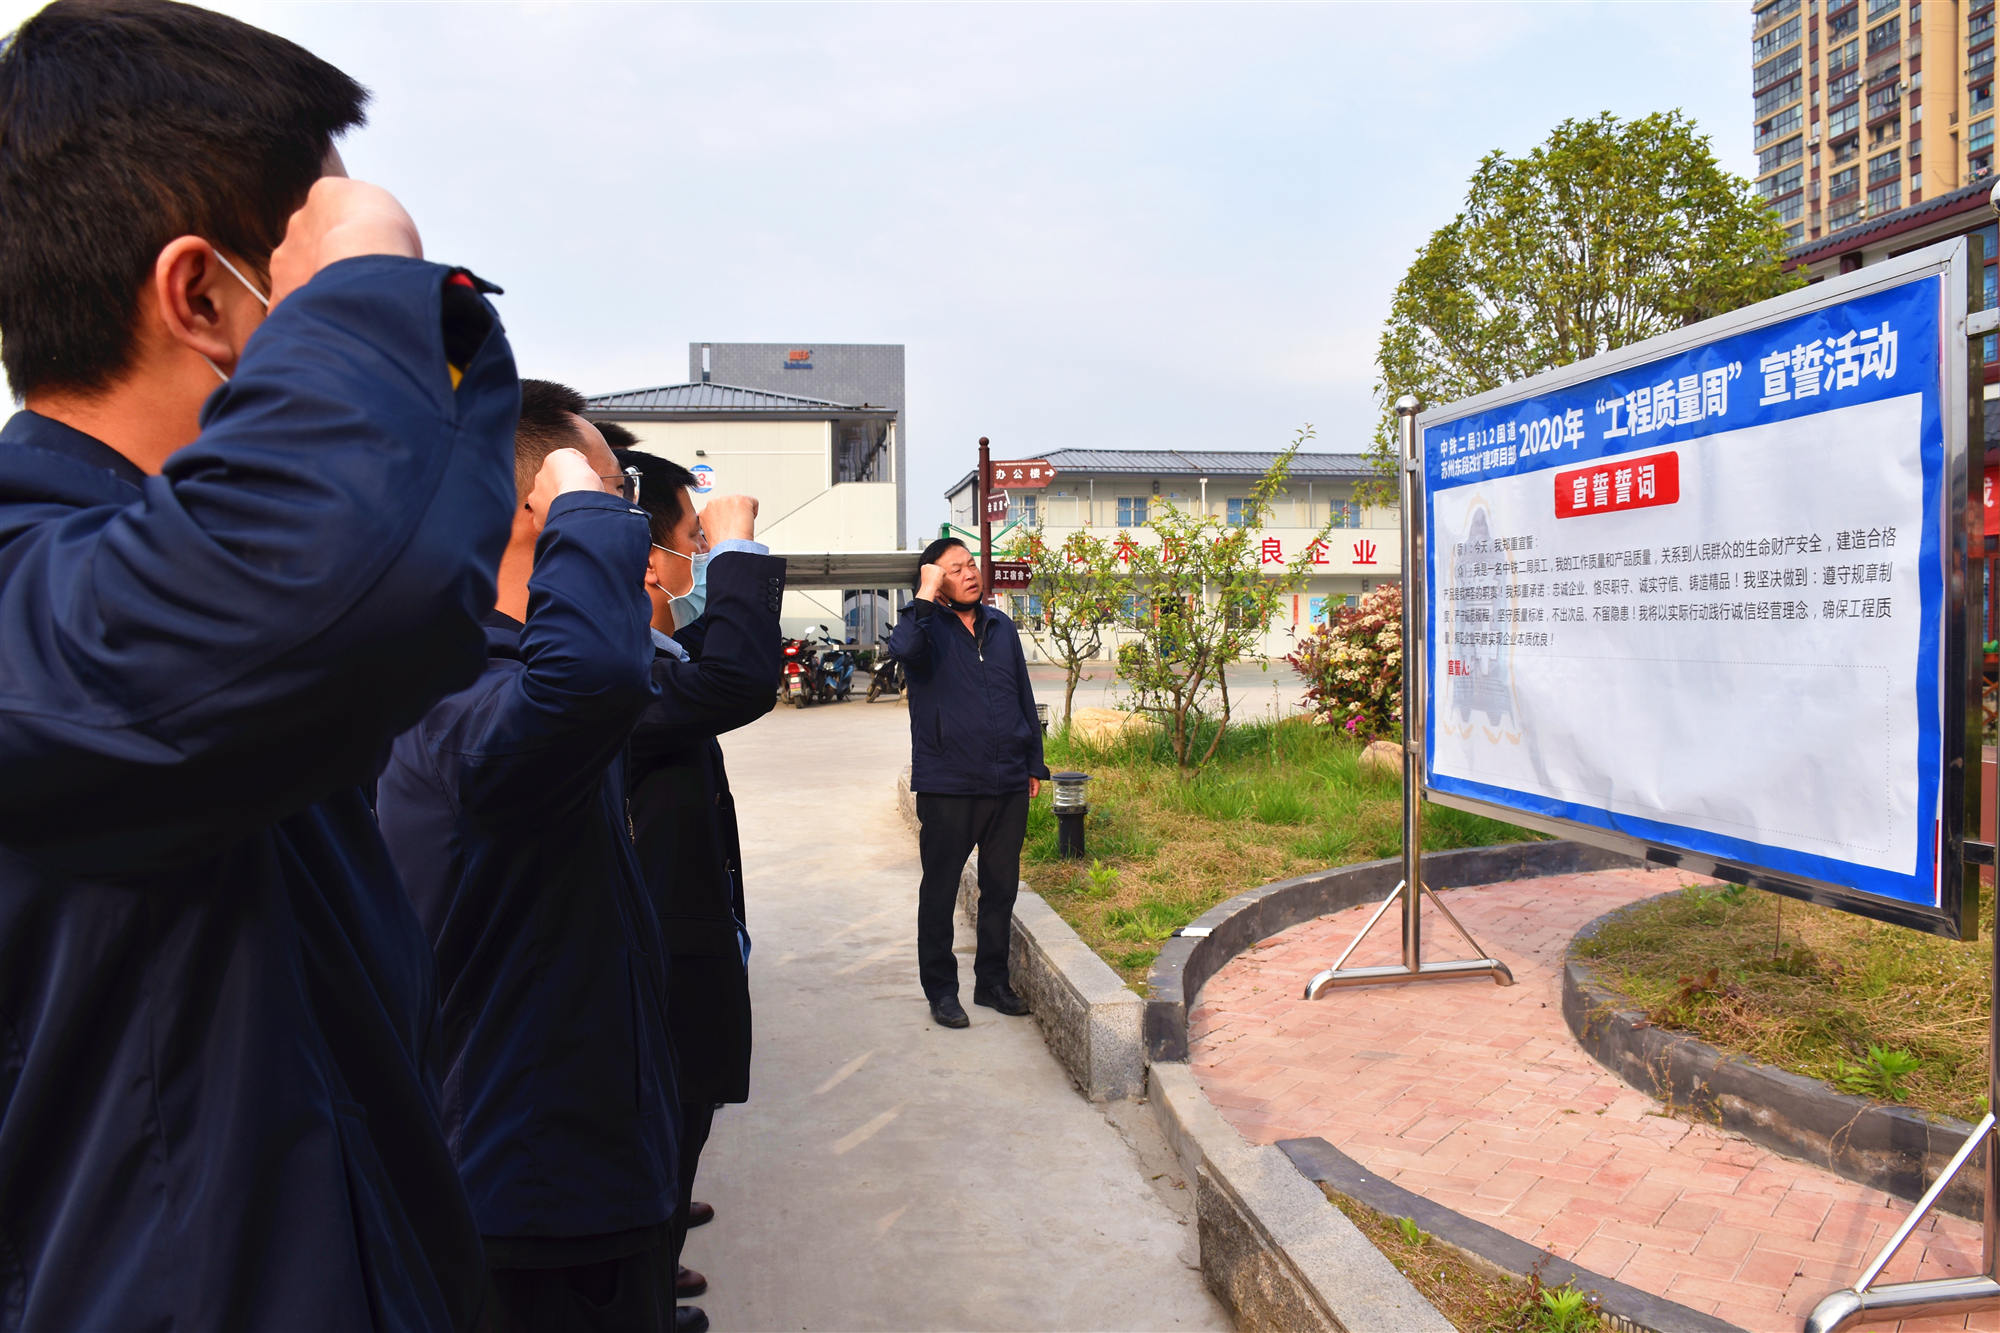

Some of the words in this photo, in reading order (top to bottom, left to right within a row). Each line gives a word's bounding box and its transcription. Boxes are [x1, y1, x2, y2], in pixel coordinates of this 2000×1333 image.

[1440, 421, 1516, 458] 中铁二局312国道
[995, 468, 1041, 480] 办公楼
[1572, 463, 1655, 509] 宣誓誓词
[994, 570, 1025, 581] 员工宿舍
